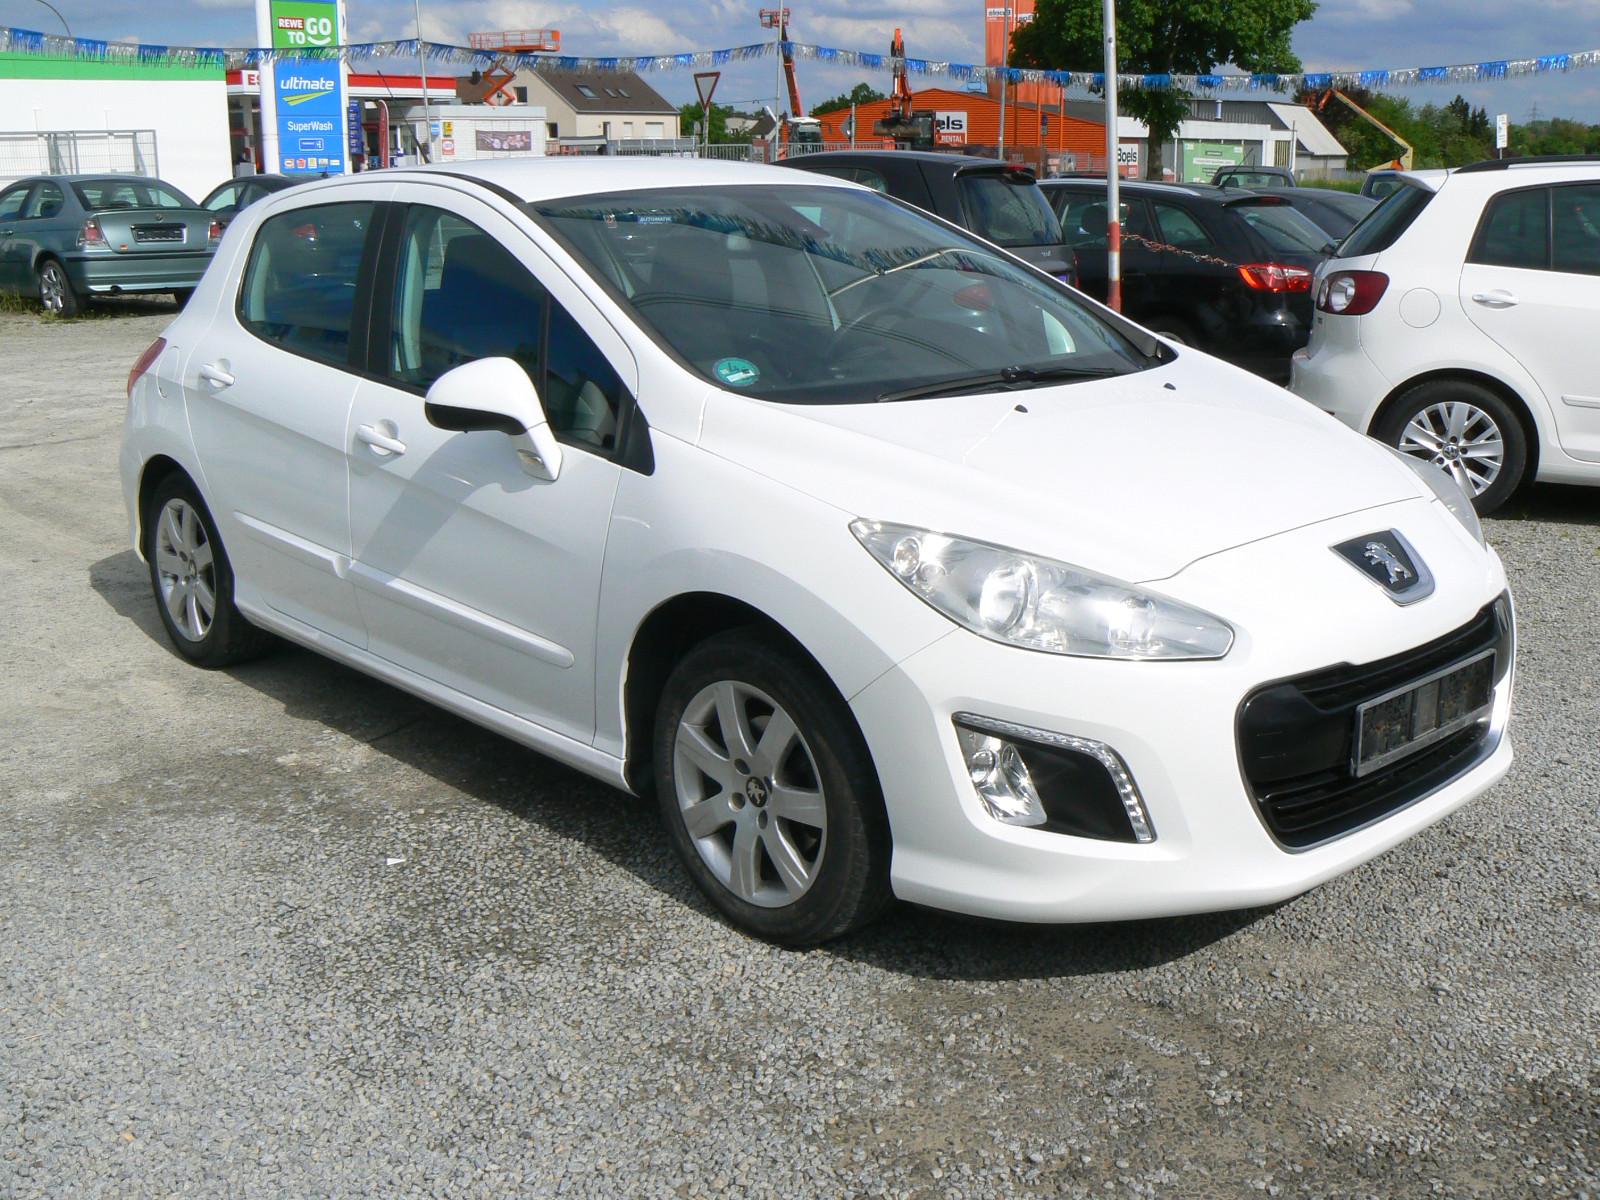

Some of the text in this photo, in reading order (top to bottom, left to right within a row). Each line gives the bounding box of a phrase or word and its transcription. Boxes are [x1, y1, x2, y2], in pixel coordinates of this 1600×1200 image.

[278, 18, 303, 29] REWE
[287, 17, 332, 44] TO GO
[280, 76, 334, 90] ultimate
[287, 121, 333, 132] SuperWash
[936, 115, 963, 130] els
